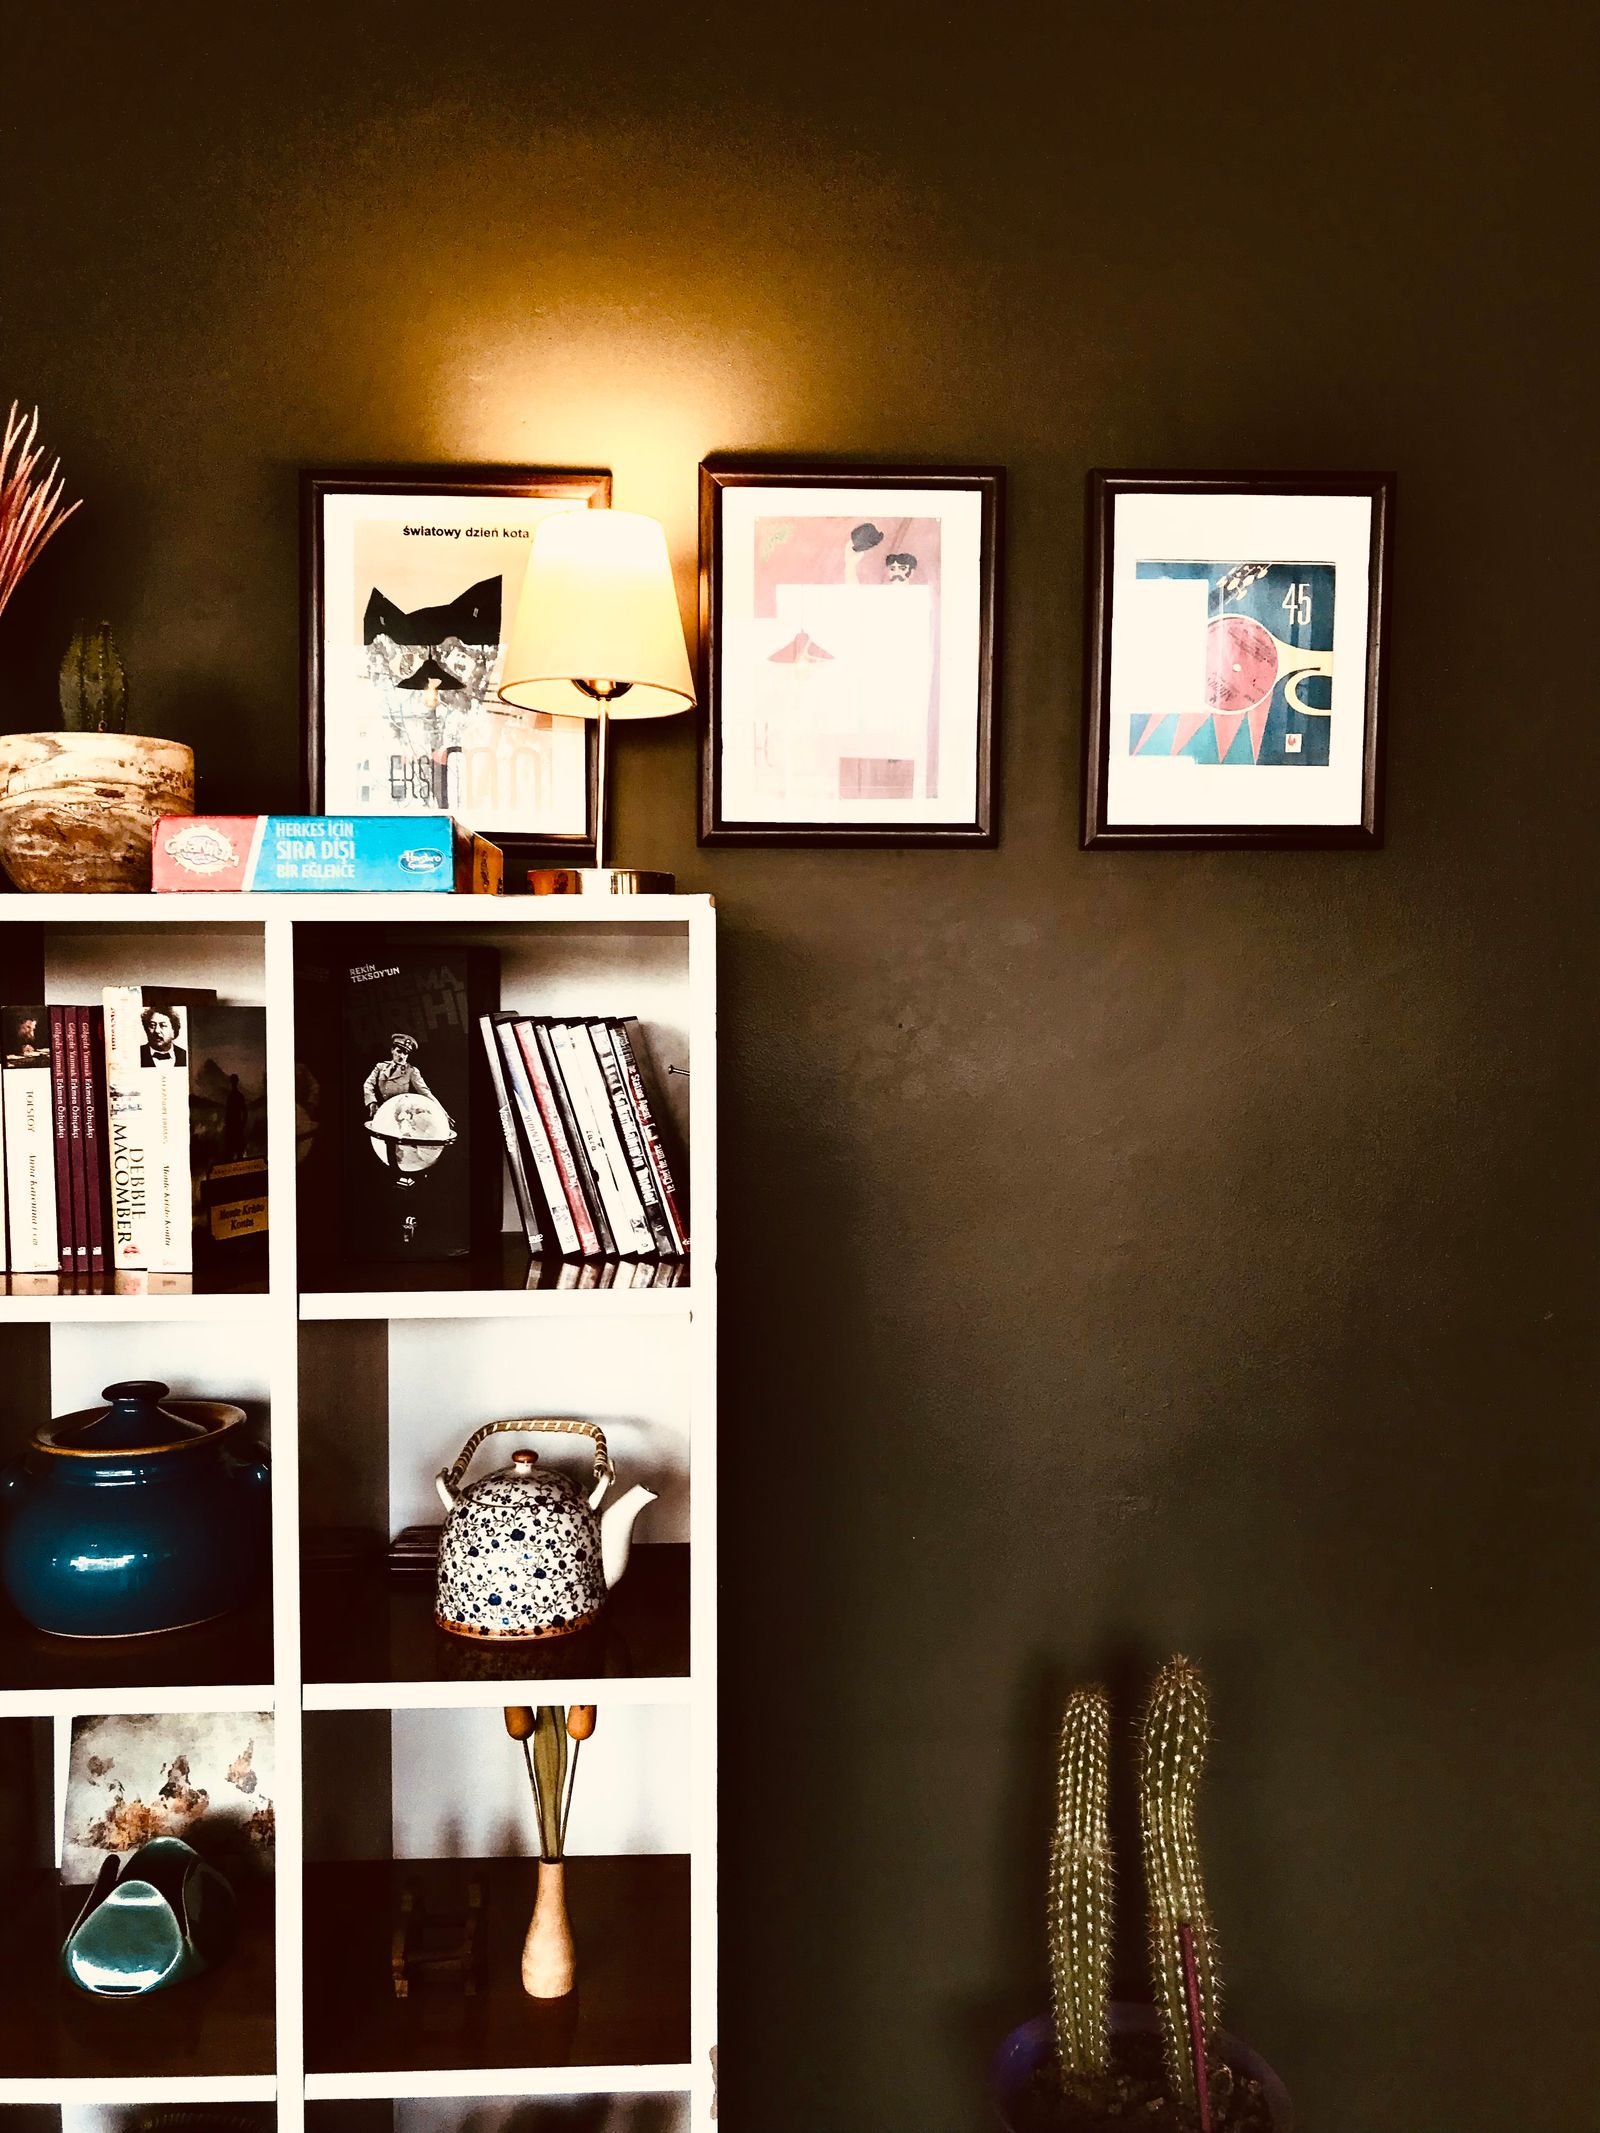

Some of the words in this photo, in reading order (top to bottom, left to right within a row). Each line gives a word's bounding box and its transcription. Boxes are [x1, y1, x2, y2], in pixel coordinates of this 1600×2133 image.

[403, 525, 461, 539] światowy
[465, 527, 499, 538] dzień
[502, 528, 530, 539] kota
[1282, 583, 1312, 625] 45
[276, 823, 325, 837] HERKES
[328, 823, 354, 840] İÇİN
[276, 841, 316, 860] SIRA
[400, 850, 442, 863] Hasbro
[277, 863, 299, 878] BİR
[350, 964, 376, 976] REKİN
[26, 1090, 35, 1133] TOLSTOY
[113, 1123, 132, 1244] MACOMBER
[129, 1148, 147, 1220] DEBBIE
